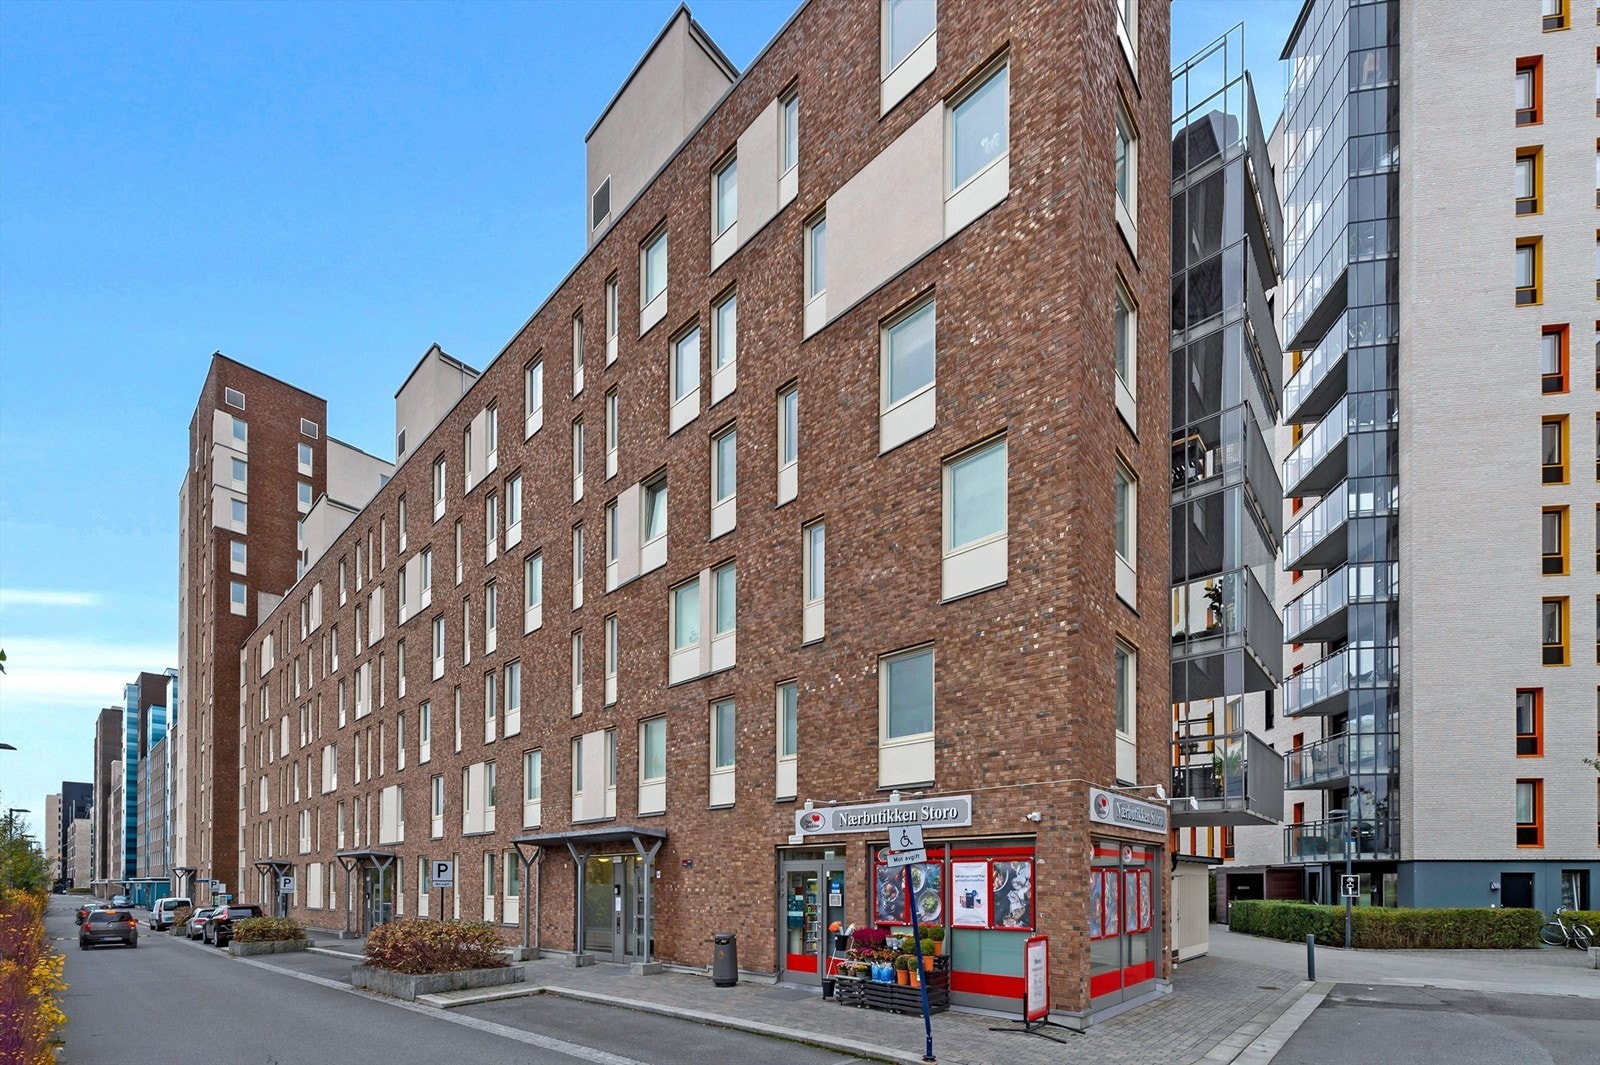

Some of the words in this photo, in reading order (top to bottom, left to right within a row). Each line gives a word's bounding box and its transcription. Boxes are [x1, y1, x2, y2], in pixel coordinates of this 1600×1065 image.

[839, 808, 919, 827] Nærbutikken
[921, 805, 959, 821] Storo
[904, 854, 921, 862] avgift
[438, 863, 448, 878] P
[283, 878, 291, 887] P
